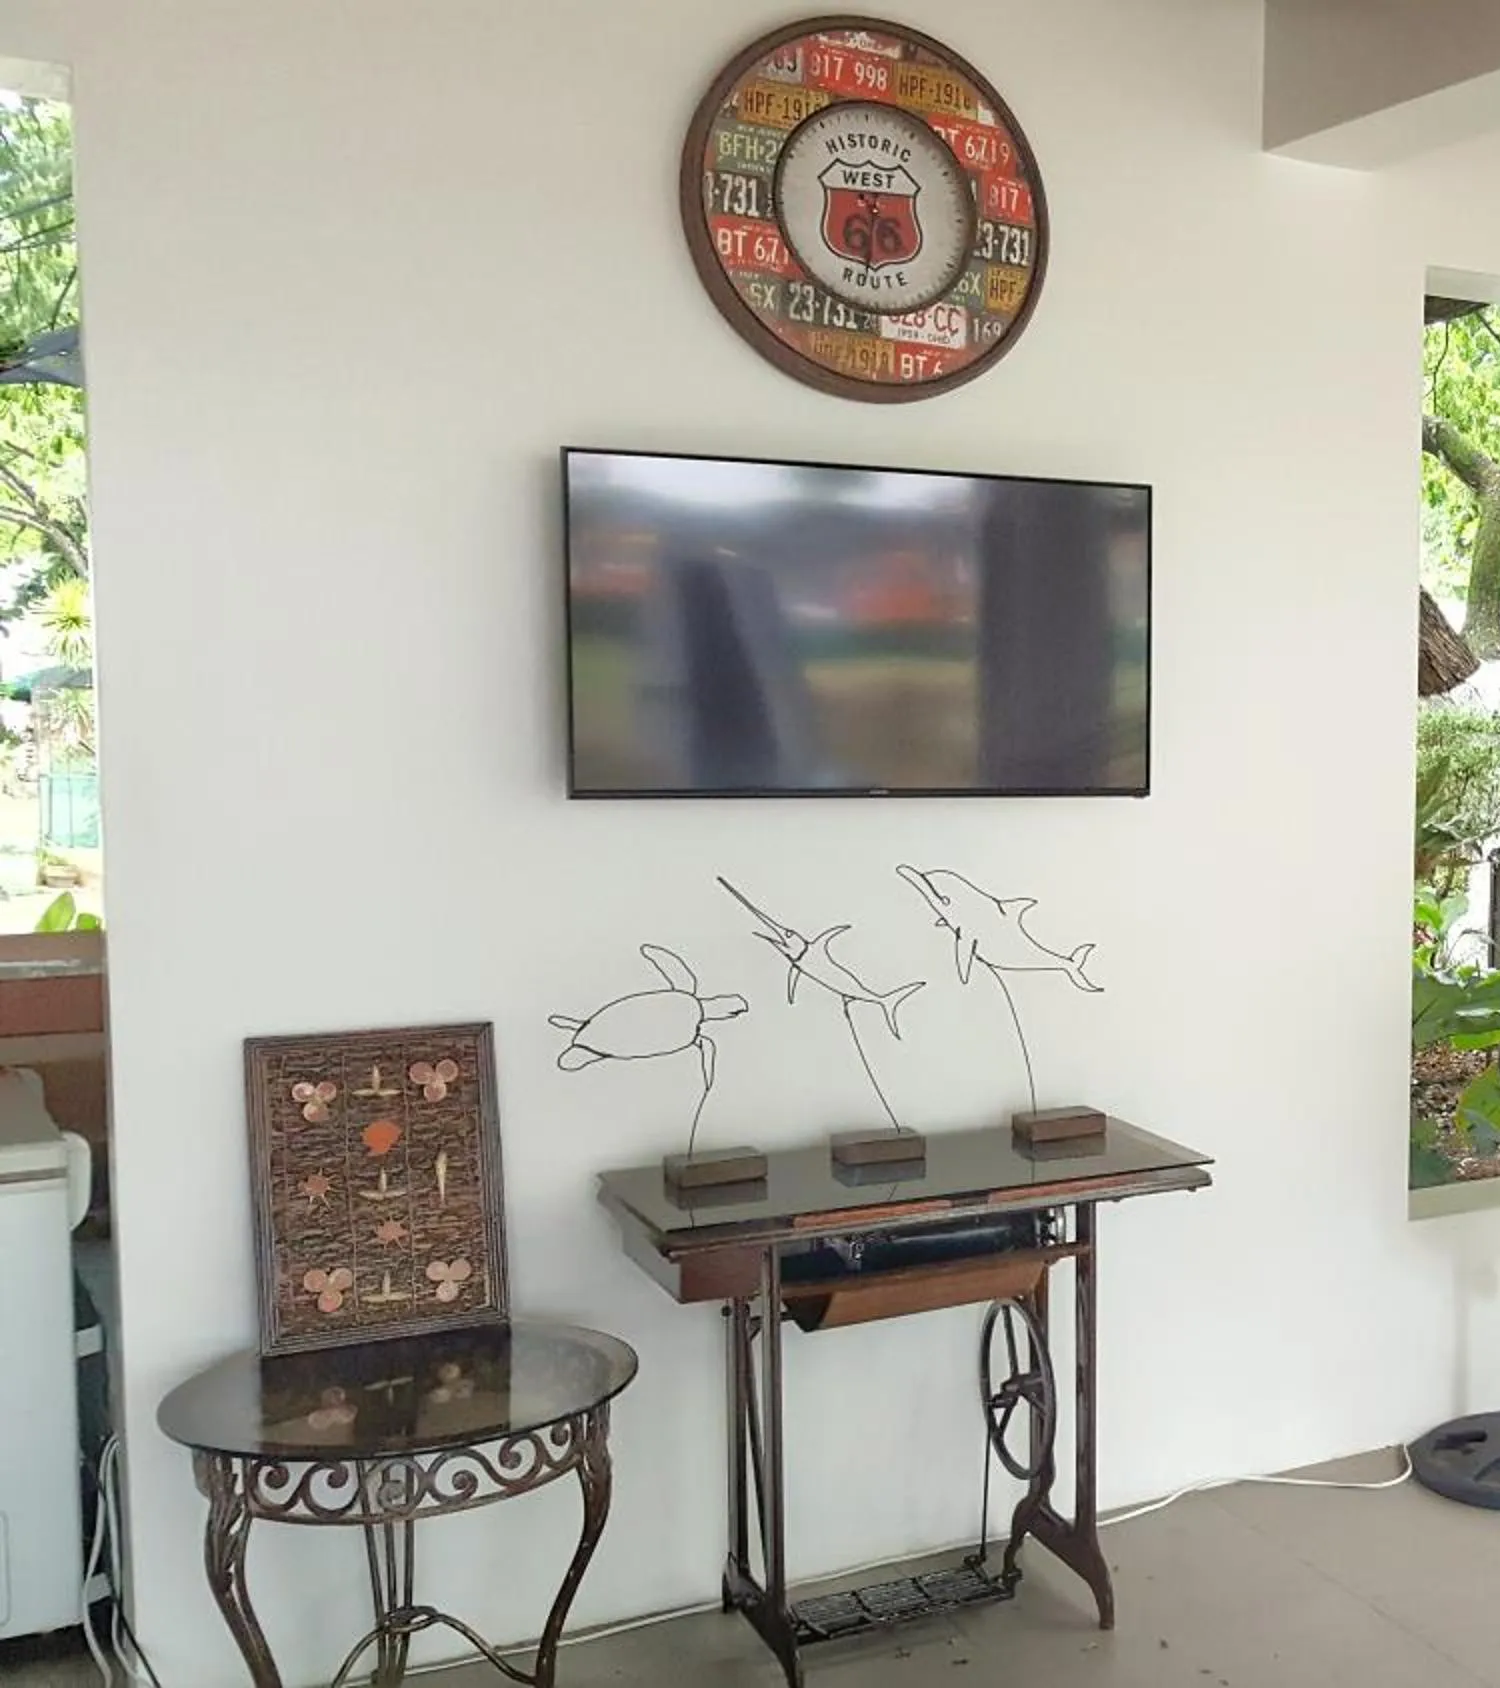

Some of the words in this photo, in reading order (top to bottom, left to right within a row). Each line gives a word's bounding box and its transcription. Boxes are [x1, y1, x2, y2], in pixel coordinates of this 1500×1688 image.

[854, 61, 889, 92] 998
[719, 131, 784, 164] BFH-2
[825, 133, 912, 163] HISTORIC
[842, 169, 896, 189] WEST
[716, 226, 748, 258] BT
[843, 213, 903, 258] 66
[841, 266, 909, 290] ROUTE
[900, 352, 929, 380] BT
